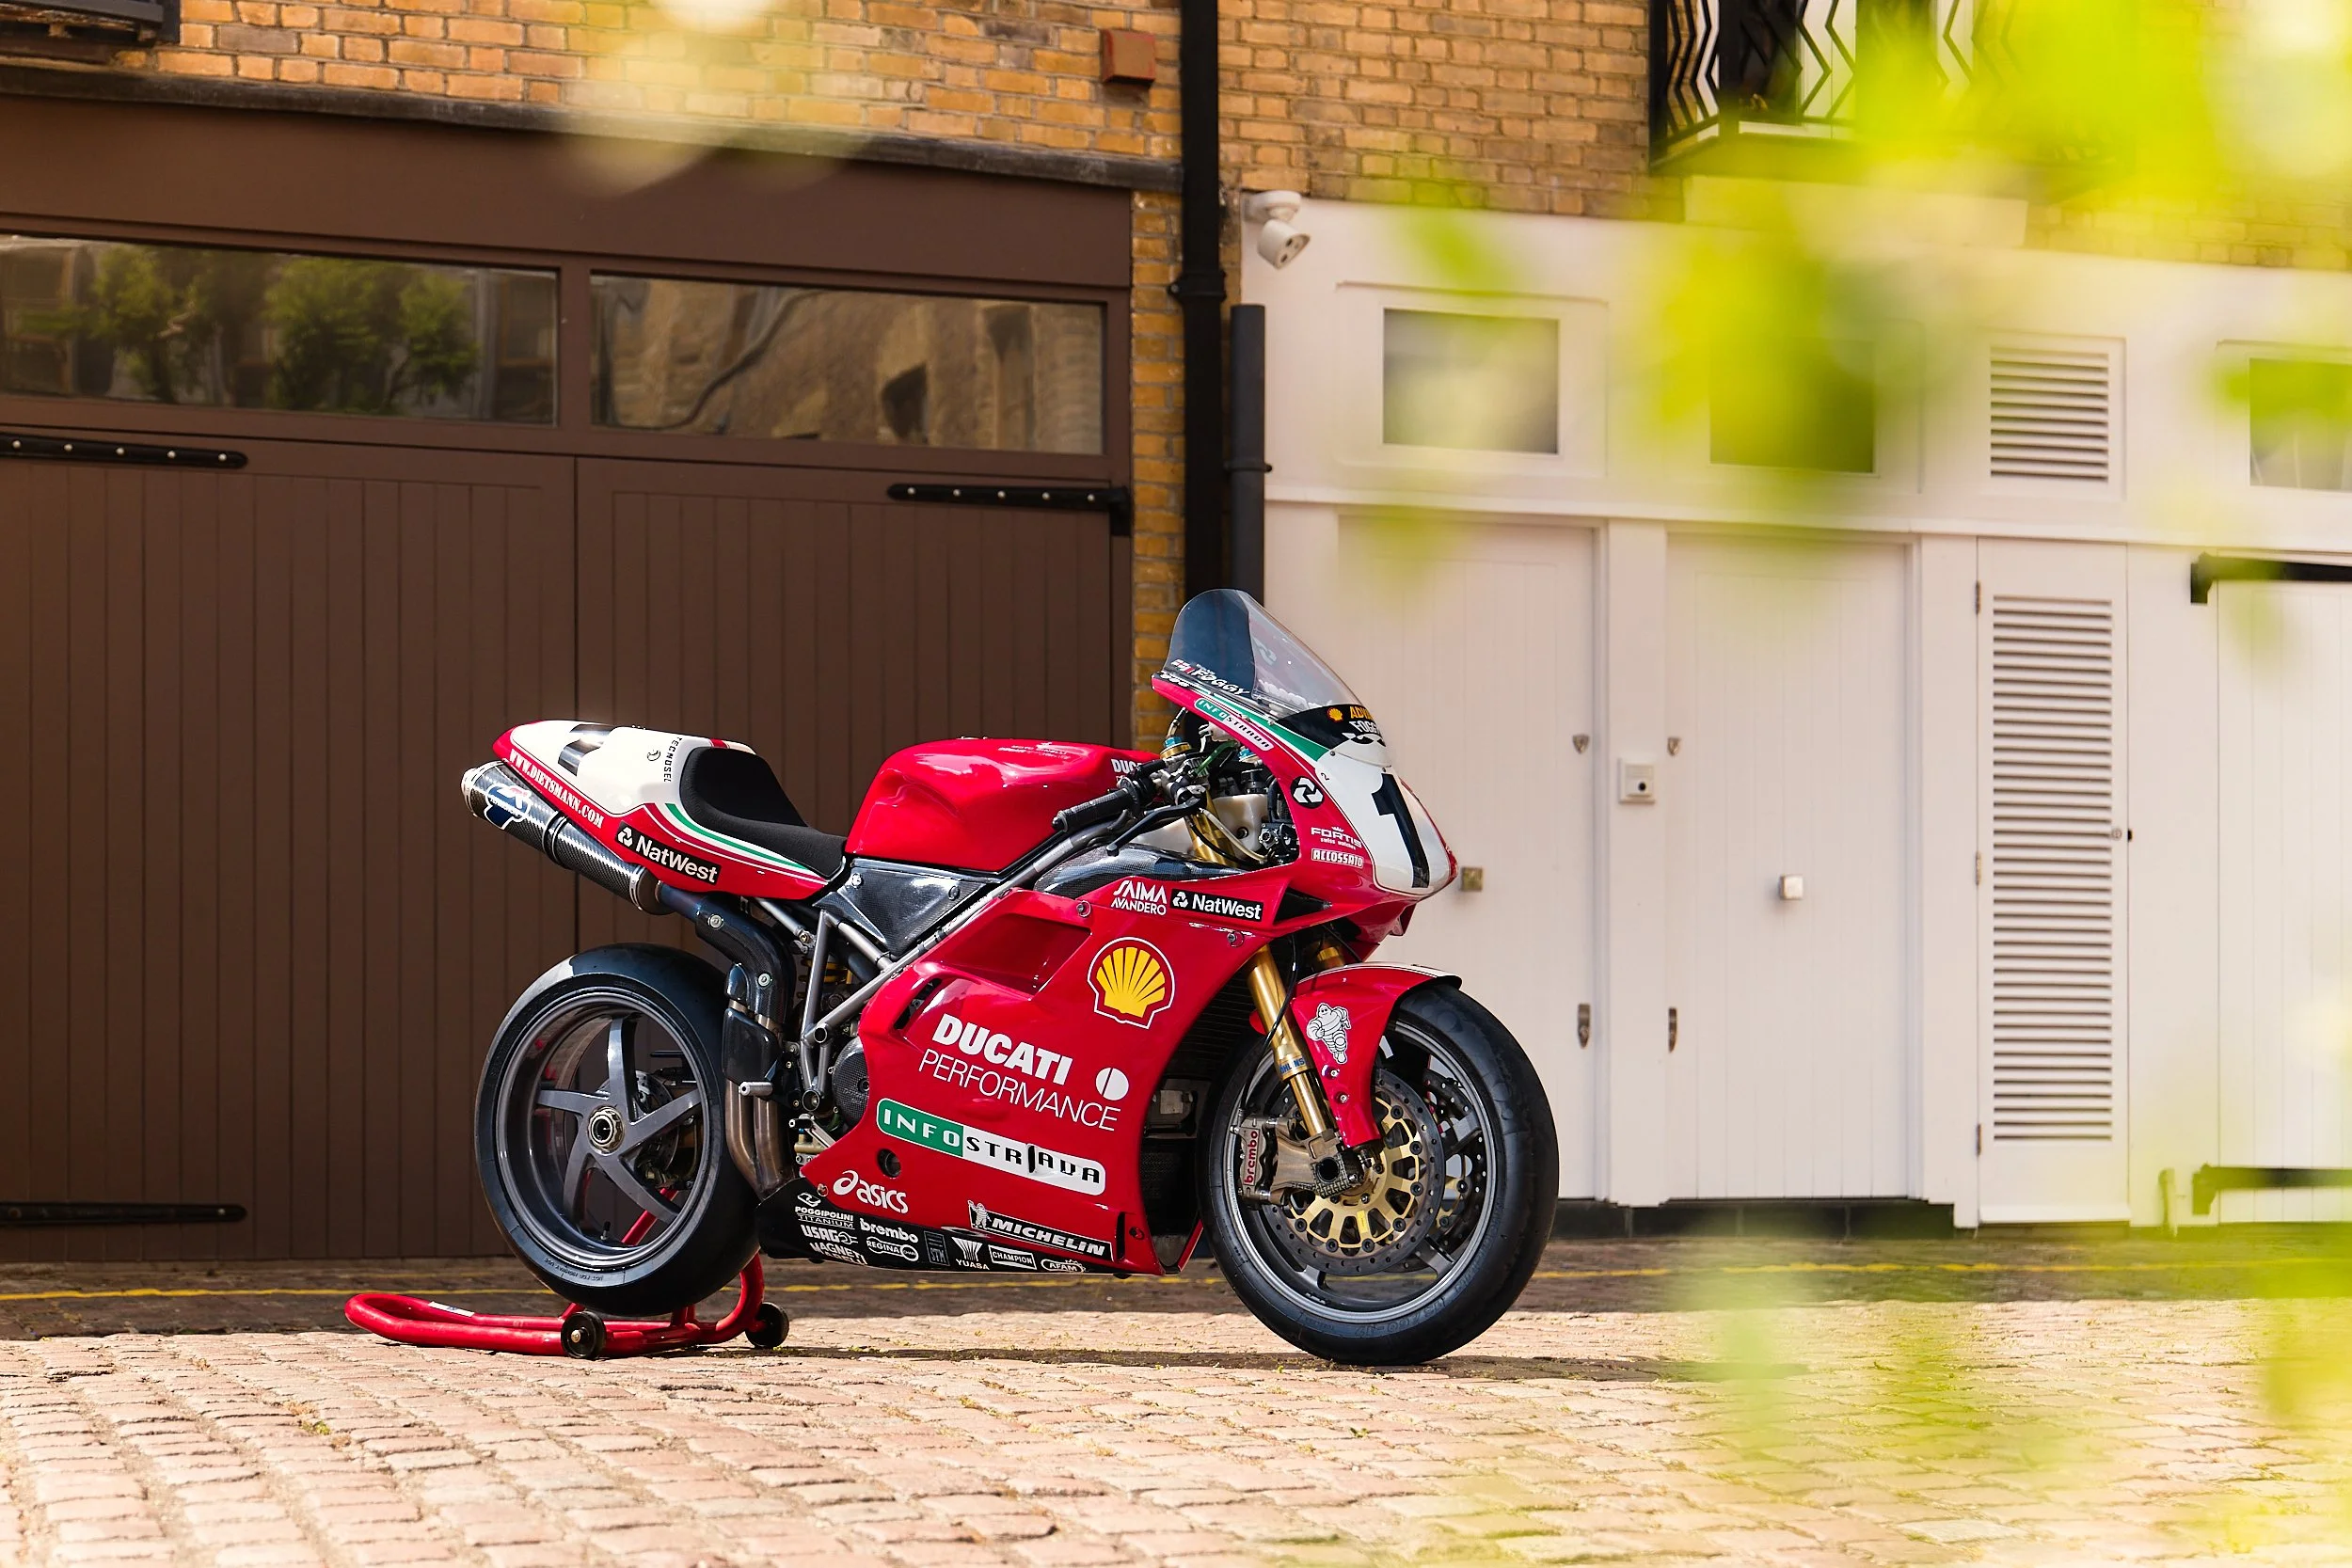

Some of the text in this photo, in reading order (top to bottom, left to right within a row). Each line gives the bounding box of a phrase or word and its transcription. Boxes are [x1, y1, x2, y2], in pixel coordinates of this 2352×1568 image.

[1198, 700, 1269, 748] INFOSTRADA
[509, 748, 605, 829] WWW.DIETSMANN.COM
[1311, 827, 1362, 848] FORTIS
[1371, 772, 1430, 888] 1
[636, 838, 719, 884] NatWest
[1312, 849, 1363, 867] ACCOSSATO
[1113, 879, 1168, 904] SAIMA
[1111, 896, 1167, 916] AVANDERO
[1192, 894, 1263, 920] NatWest
[932, 1013, 1073, 1085] DUCATI
[918, 1049, 1121, 1132] PERFORMANCE
[882, 1108, 1101, 1183] INFOSTRADA
[1244, 1130, 1259, 1184] brembo
[856, 1177, 909, 1214] asics
[795, 1206, 854, 1222] POGGIPOLINI
[798, 1214, 854, 1228] TITANIUM
[800, 1224, 840, 1243] USAG
[859, 1217, 919, 1243] brembo
[992, 1218, 1105, 1256] MICHELIN
[809, 1242, 868, 1265] MAGNETI
[866, 1240, 900, 1254] REGINA
[992, 1251, 1033, 1265] CHAMPION
[955, 1259, 991, 1271] YUASA
[1049, 1262, 1078, 1272] AFAM
